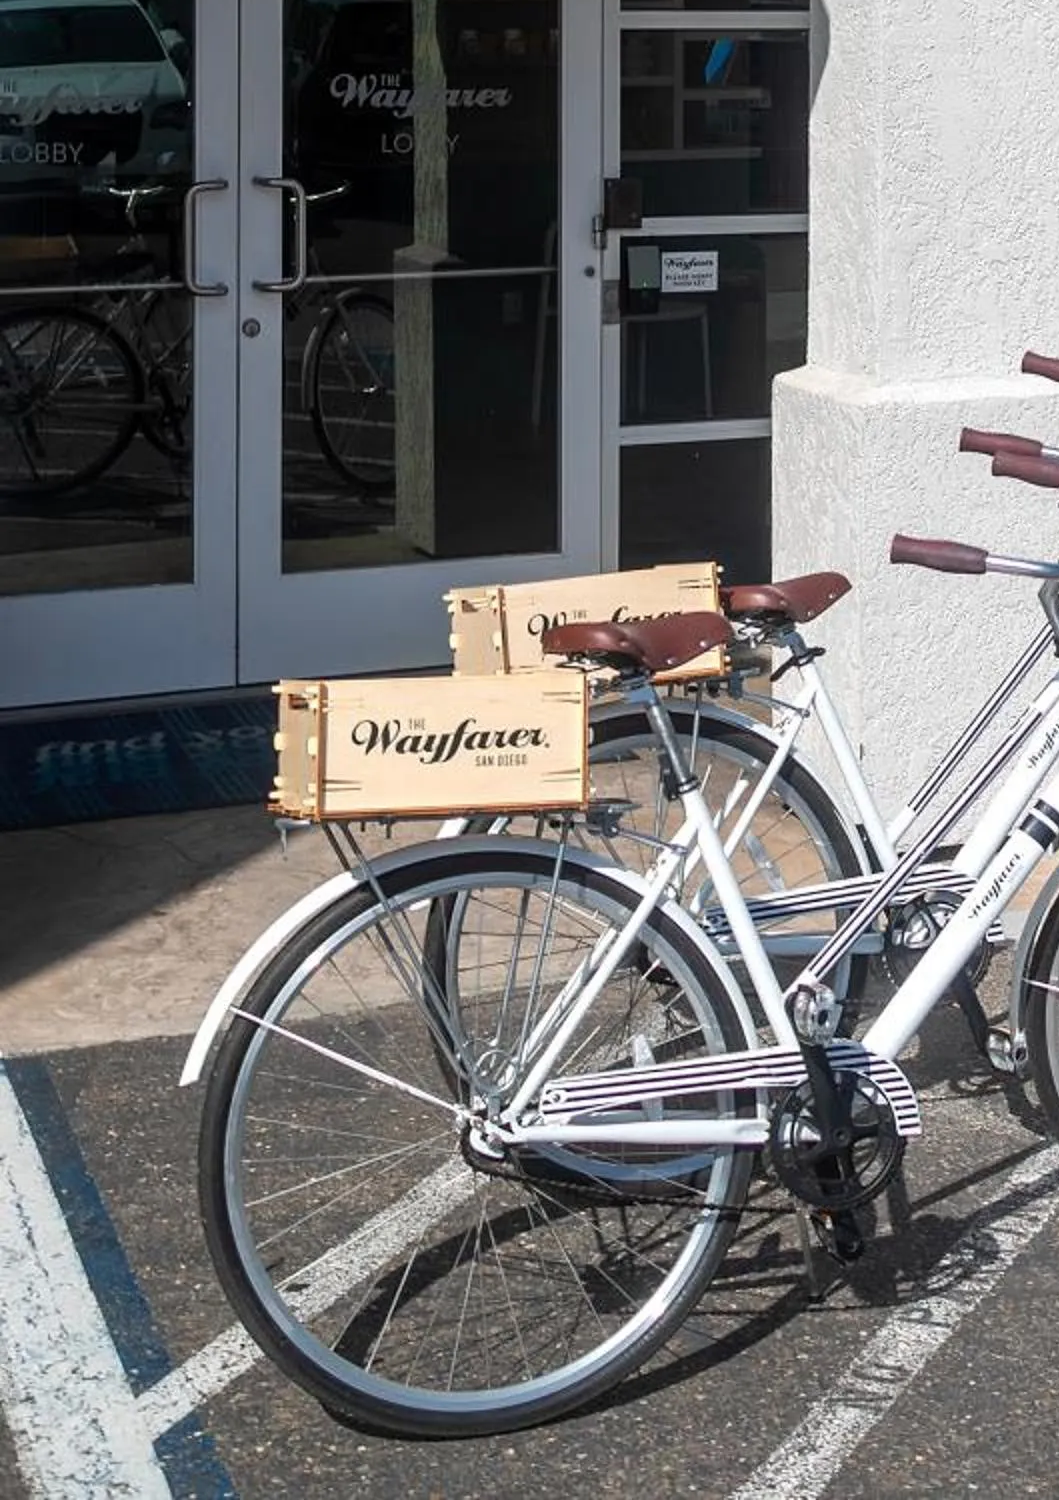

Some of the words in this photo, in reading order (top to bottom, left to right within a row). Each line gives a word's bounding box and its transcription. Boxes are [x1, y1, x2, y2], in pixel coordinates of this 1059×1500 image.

[329, 73, 513, 119] Wayarer
[380, 133, 460, 154] LOY
[408, 718, 426, 730] THE
[475, 755, 494, 767] SAN
[497, 754, 528, 767] DIEGO
